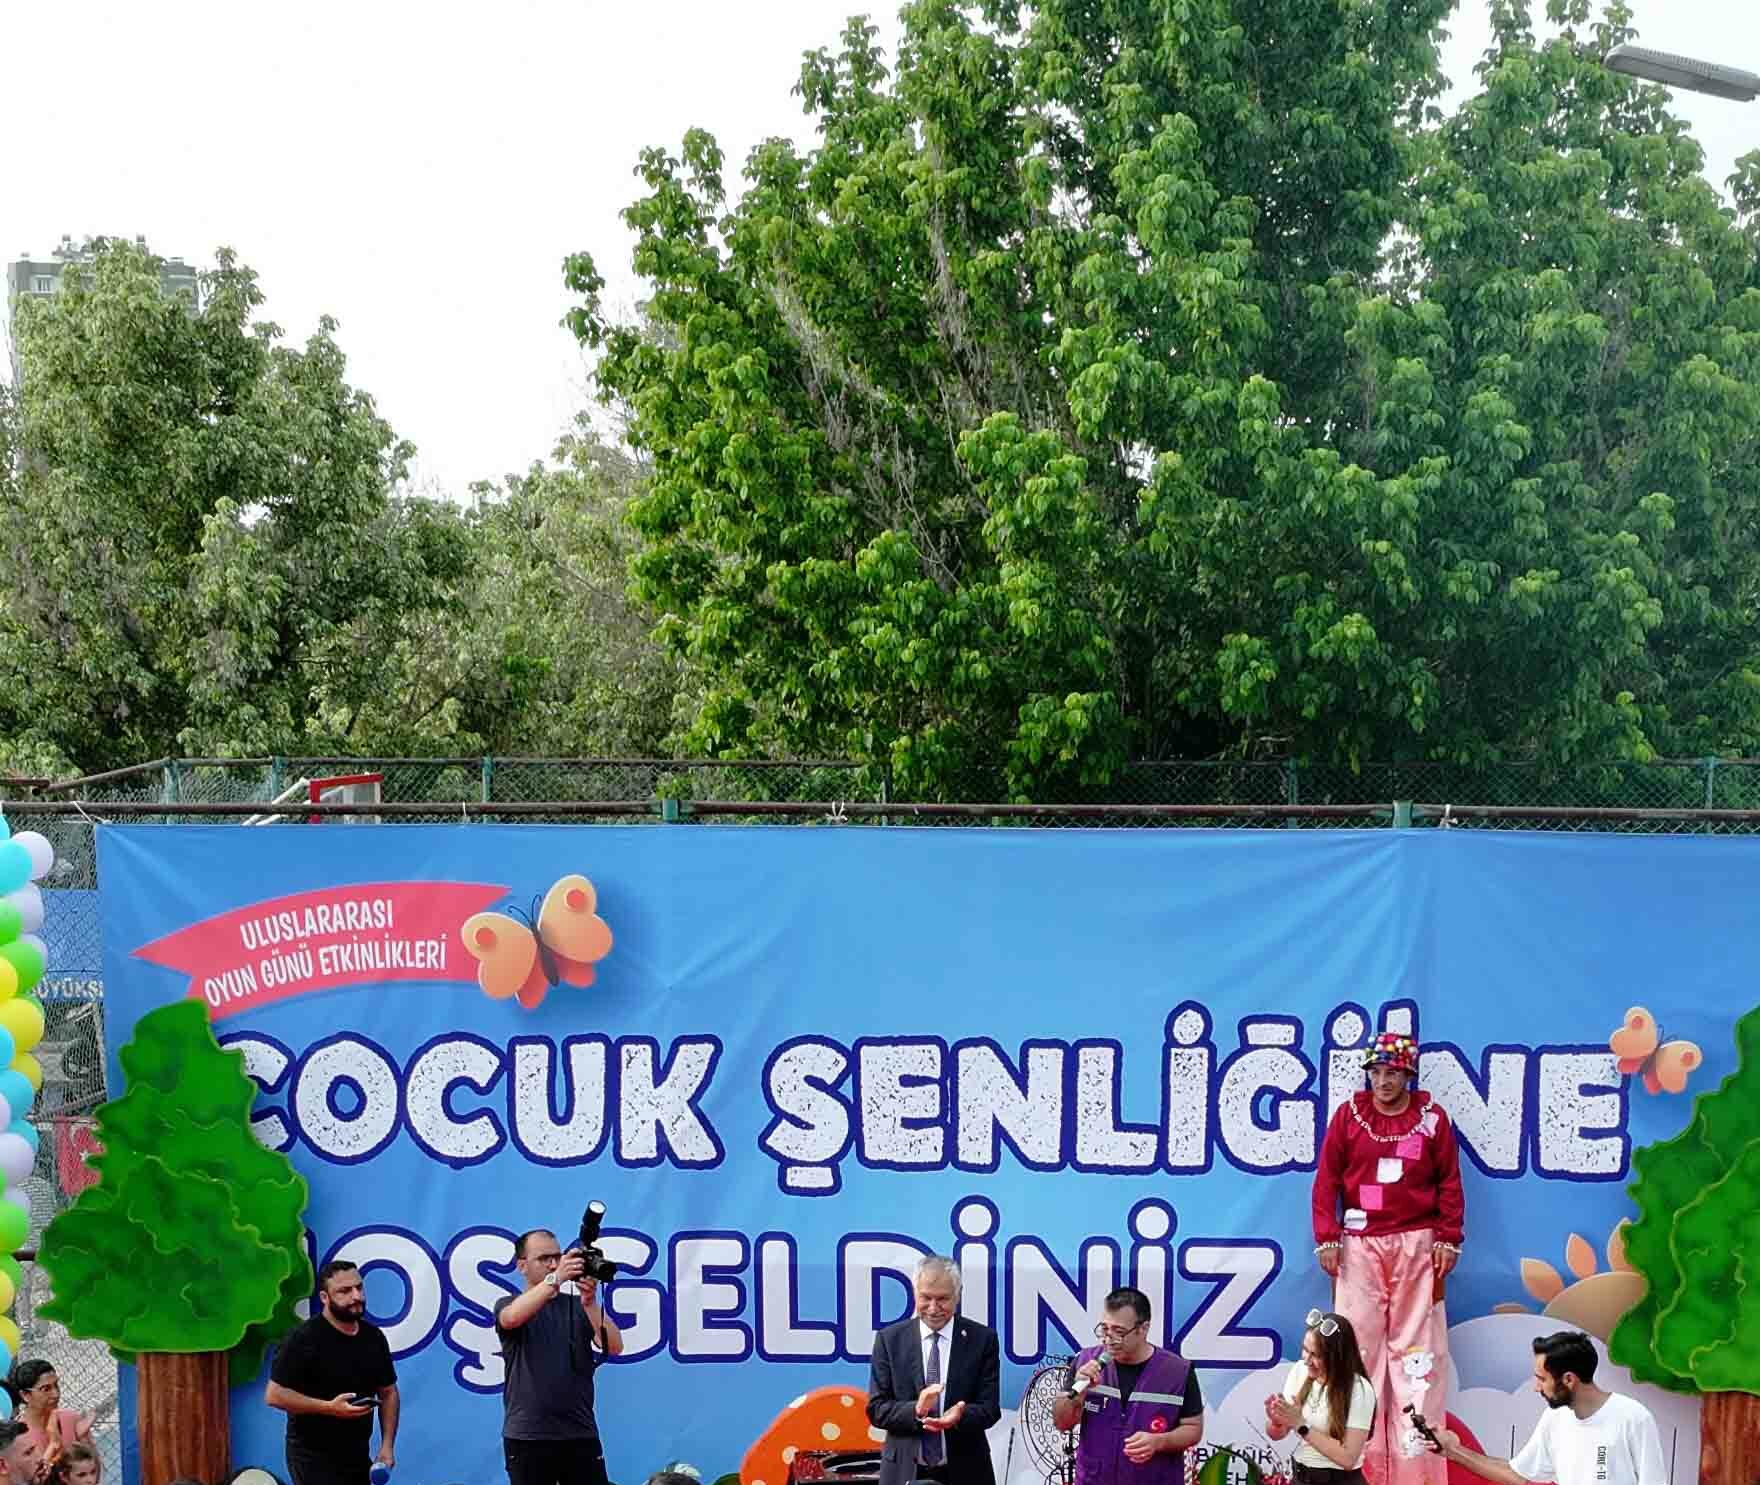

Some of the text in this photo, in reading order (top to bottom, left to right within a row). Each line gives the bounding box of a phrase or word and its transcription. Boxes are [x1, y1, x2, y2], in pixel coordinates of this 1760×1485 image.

[239, 899, 393, 950] ULUSLARARASI
[204, 932, 448, 1007] OYUN GÜNÜ ETKİNLİKLERİ
